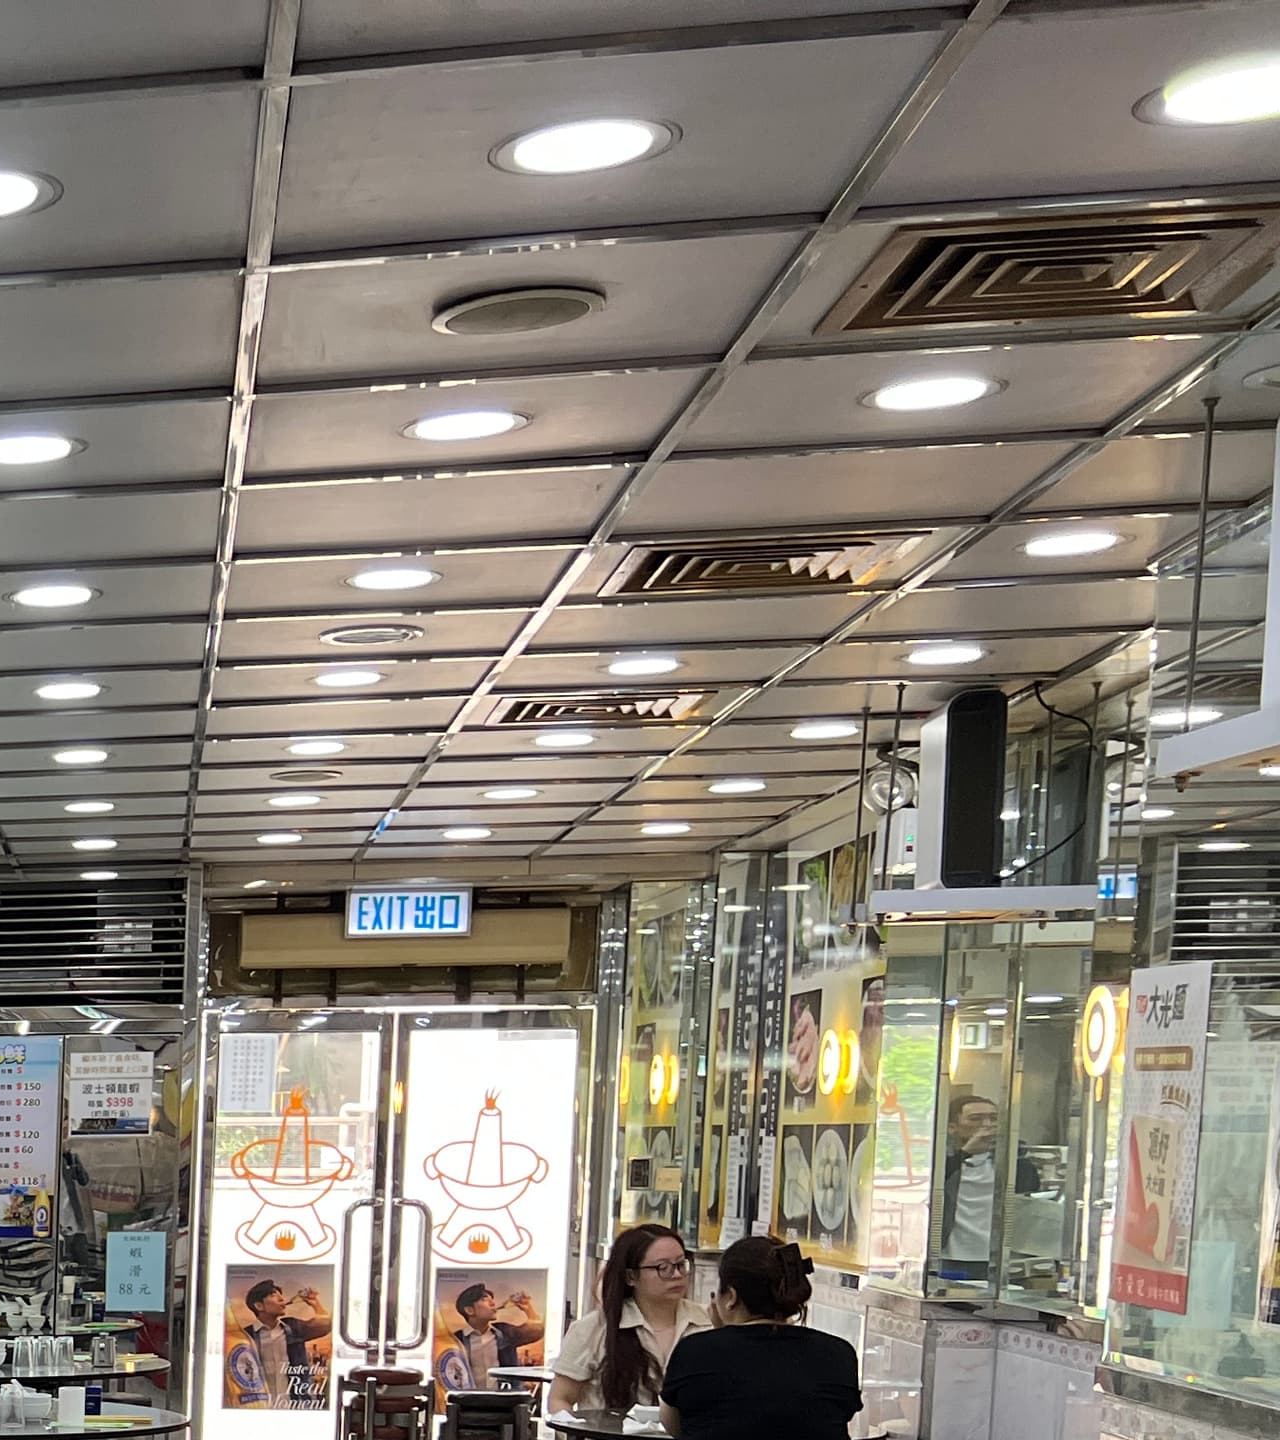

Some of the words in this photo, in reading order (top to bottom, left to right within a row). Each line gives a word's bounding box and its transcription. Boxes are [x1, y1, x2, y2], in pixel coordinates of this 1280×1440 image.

[357, 895, 409, 930] EXIT
[414, 895, 460, 929] 出口
[106, 1097, 134, 1107] $398
[119, 1283, 133, 1295] 88
[139, 1284, 151, 1295] 元
[280, 1361, 308, 1374] Taste
[309, 1361, 328, 1374] the
[286, 1376, 328, 1395] Real
